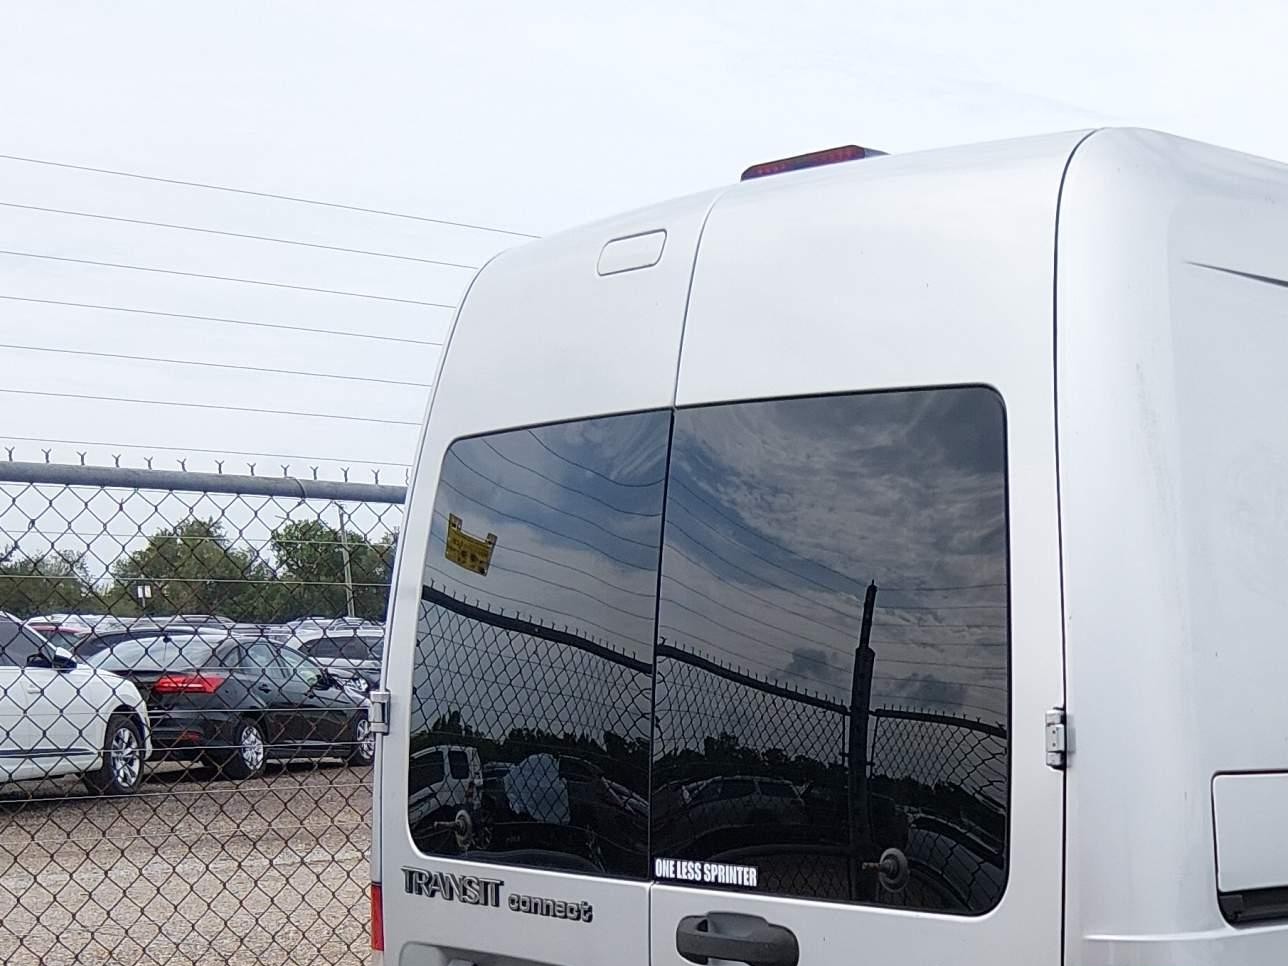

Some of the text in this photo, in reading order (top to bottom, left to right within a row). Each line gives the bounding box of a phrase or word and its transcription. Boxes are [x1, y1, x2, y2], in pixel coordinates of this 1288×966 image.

[655, 858, 758, 887] ONE LESS SPRINTER
[402, 867, 594, 923] TRANSIT connect
